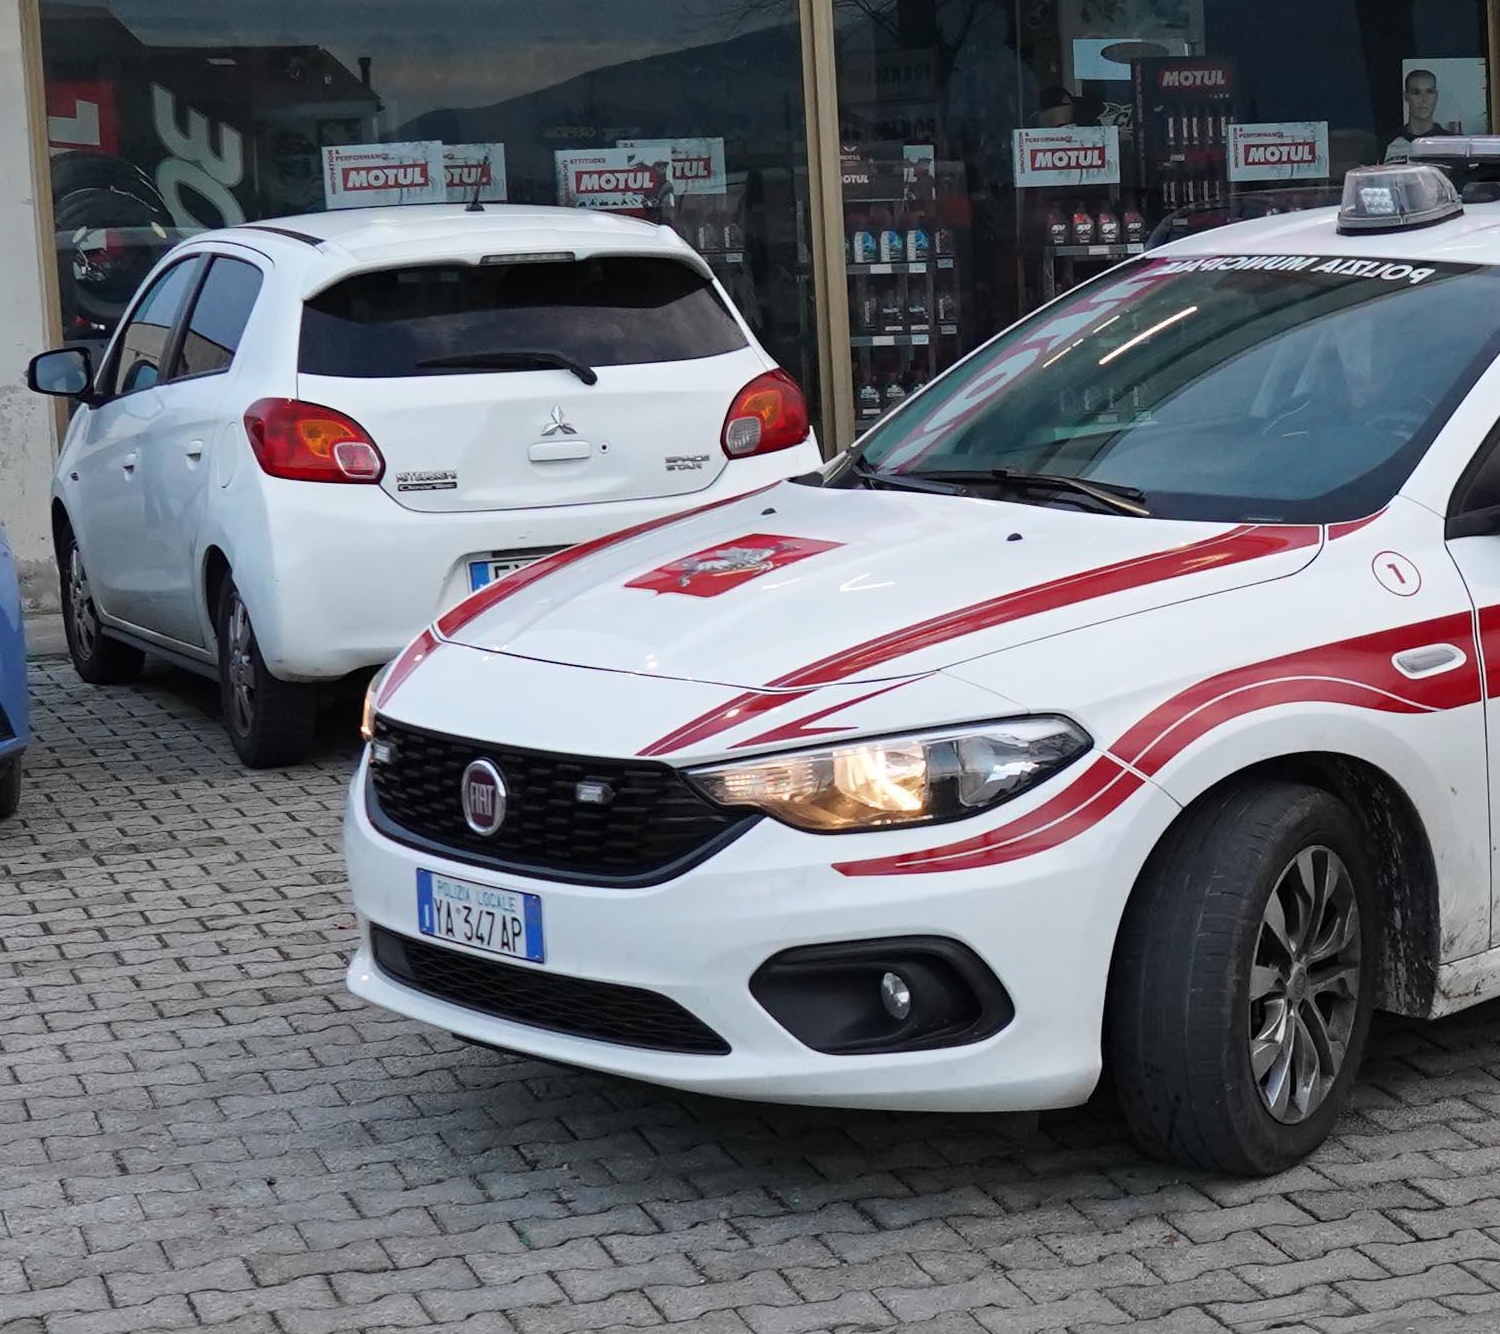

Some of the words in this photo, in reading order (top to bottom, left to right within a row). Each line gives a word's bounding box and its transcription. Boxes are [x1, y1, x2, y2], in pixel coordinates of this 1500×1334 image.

[1162, 69, 1227, 87] MOTUL
[1033, 149, 1103, 169] MOTUL
[1247, 145, 1313, 163] MOTUL
[346, 167, 426, 187] MOTUL
[579, 172, 654, 191] MOTUL
[842, 174, 869, 184] OTUL
[468, 781, 496, 818] FIAT
[437, 880, 470, 901] POLIZIA
[477, 891, 516, 913] LOCALE
[433, 897, 455, 938] YA
[462, 905, 495, 946] 347
[501, 914, 523, 952] AP
